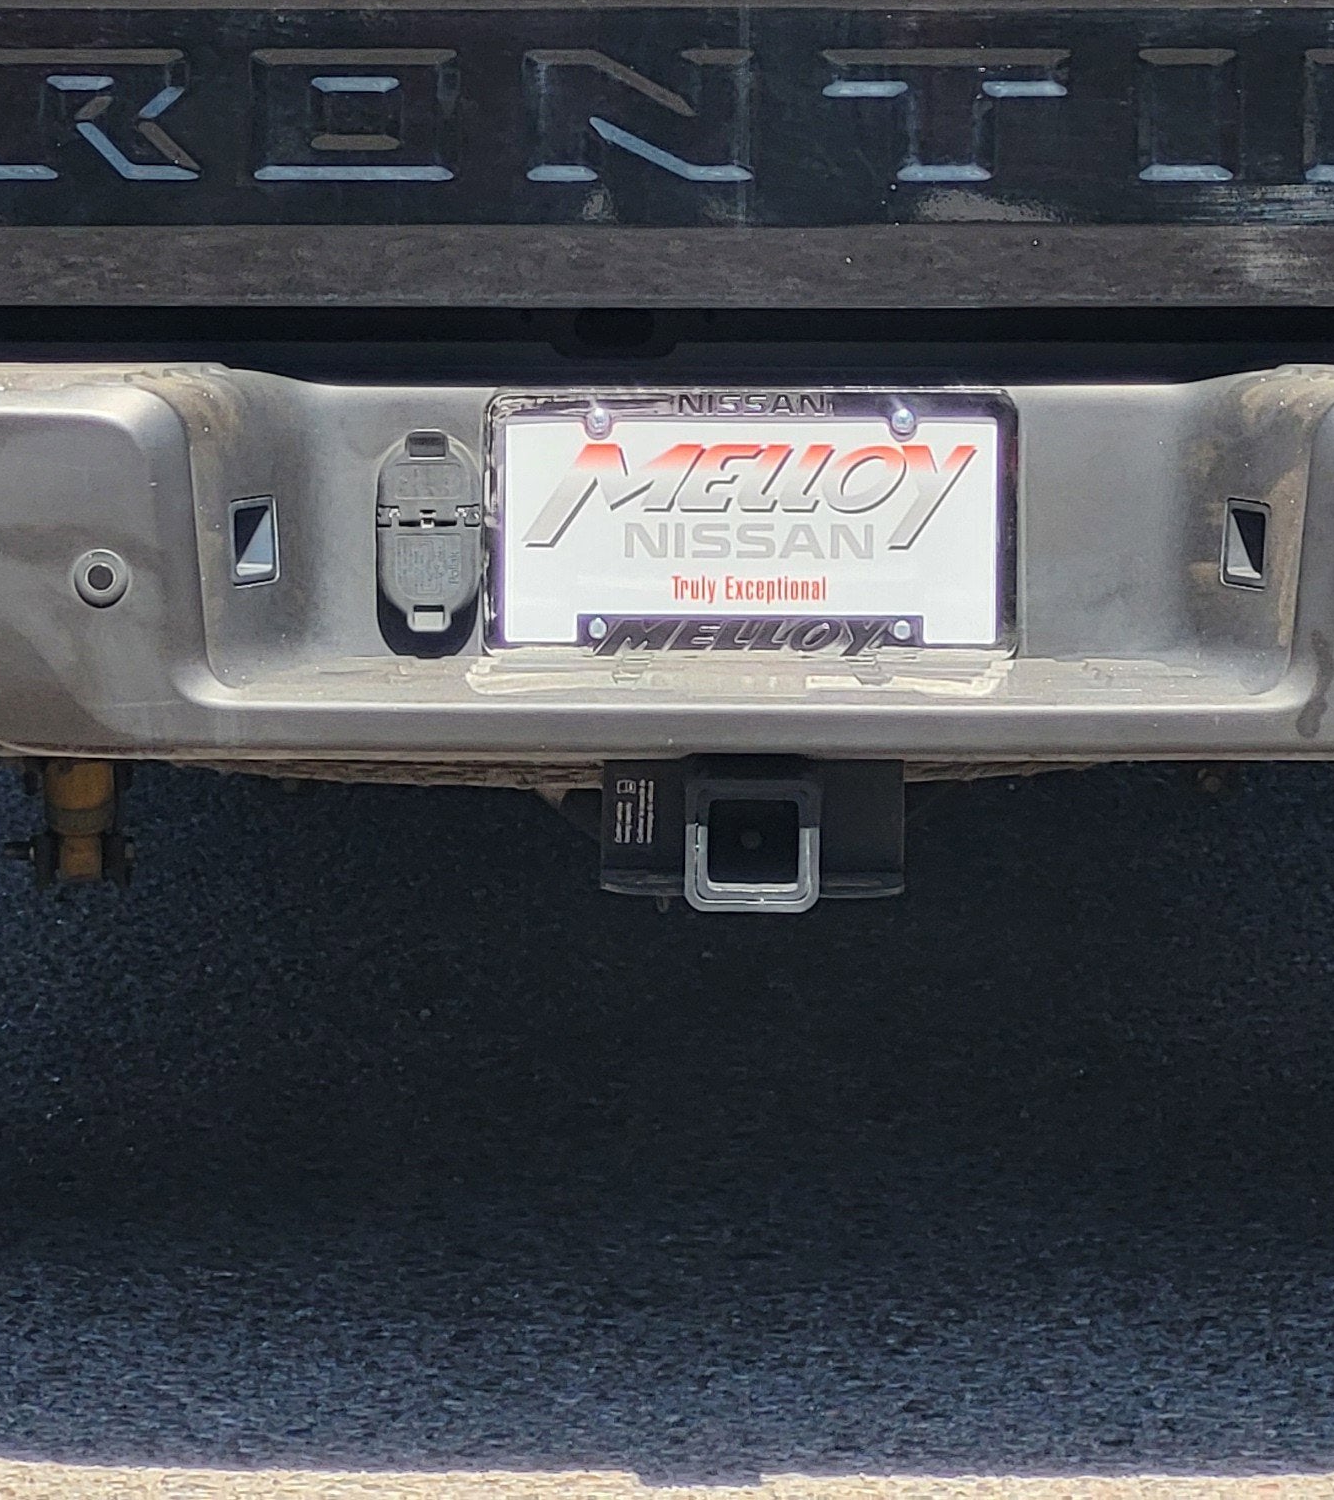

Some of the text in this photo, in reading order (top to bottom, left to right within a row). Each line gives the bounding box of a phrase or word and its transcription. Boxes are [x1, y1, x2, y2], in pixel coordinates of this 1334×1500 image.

[674, 392, 830, 417] NISSAN
[521, 442, 978, 551] MELLOY
[624, 522, 875, 560] NISSAN
[671, 574, 828, 605] Truly Exceptional
[593, 617, 897, 657] MELLOY
